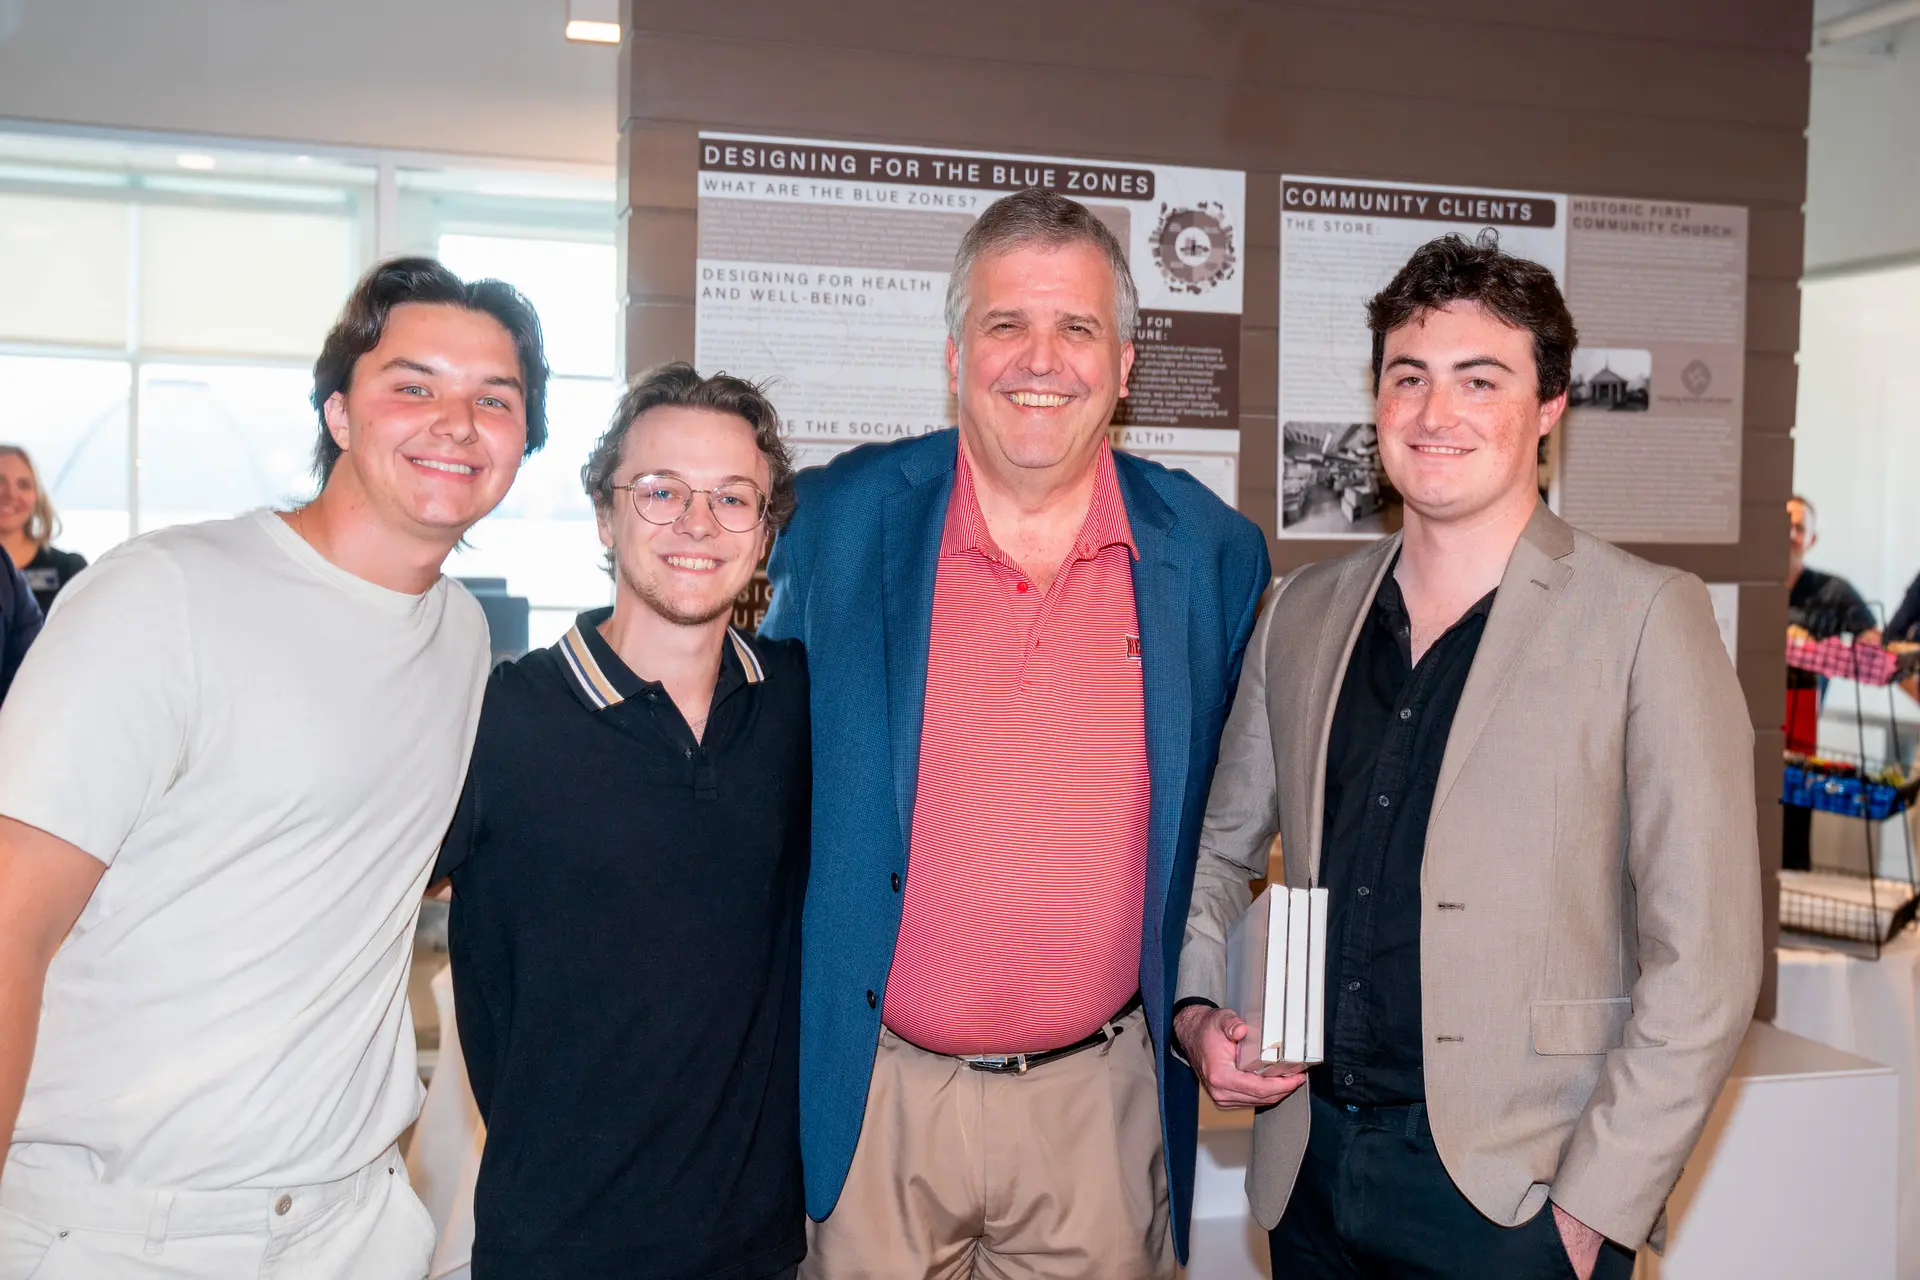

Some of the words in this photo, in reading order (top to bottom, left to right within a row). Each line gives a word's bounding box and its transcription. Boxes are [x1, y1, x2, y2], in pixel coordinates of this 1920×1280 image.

[704, 145, 857, 174] DESIGNING
[870, 157, 920, 178] FOR
[931, 161, 980, 182] THE
[992, 166, 1056, 187] BLUE
[1067, 171, 1149, 194] ZONES
[704, 179, 757, 194] WHAT
[765, 183, 799, 197] ARE
[810, 185, 844, 199] THE
[854, 188, 899, 203] BLUE
[908, 192, 977, 208] ZONES?
[1285, 187, 1429, 214] COMMUNITY
[1438, 198, 1533, 221] CLIENTS
[1573, 202, 1644, 217] HISTORIC
[1651, 205, 1692, 219] FIRST
[1286, 217, 1315, 232] THE
[1323, 220, 1381, 236] STORE:
[1572, 216, 1665, 234] COMMUNITY
[702, 268, 809, 286] DESIGNING
[818, 273, 853, 288] FOR
[862, 276, 931, 292] HEALTH
[702, 287, 741, 300] AND
[750, 288, 874, 306] WELL-BEING:
[1147, 316, 1172, 328] FOR
[1134, 329, 1168, 341] URE:
[806, 420, 840, 434] THE
[849, 422, 914, 436] SOCIAL
